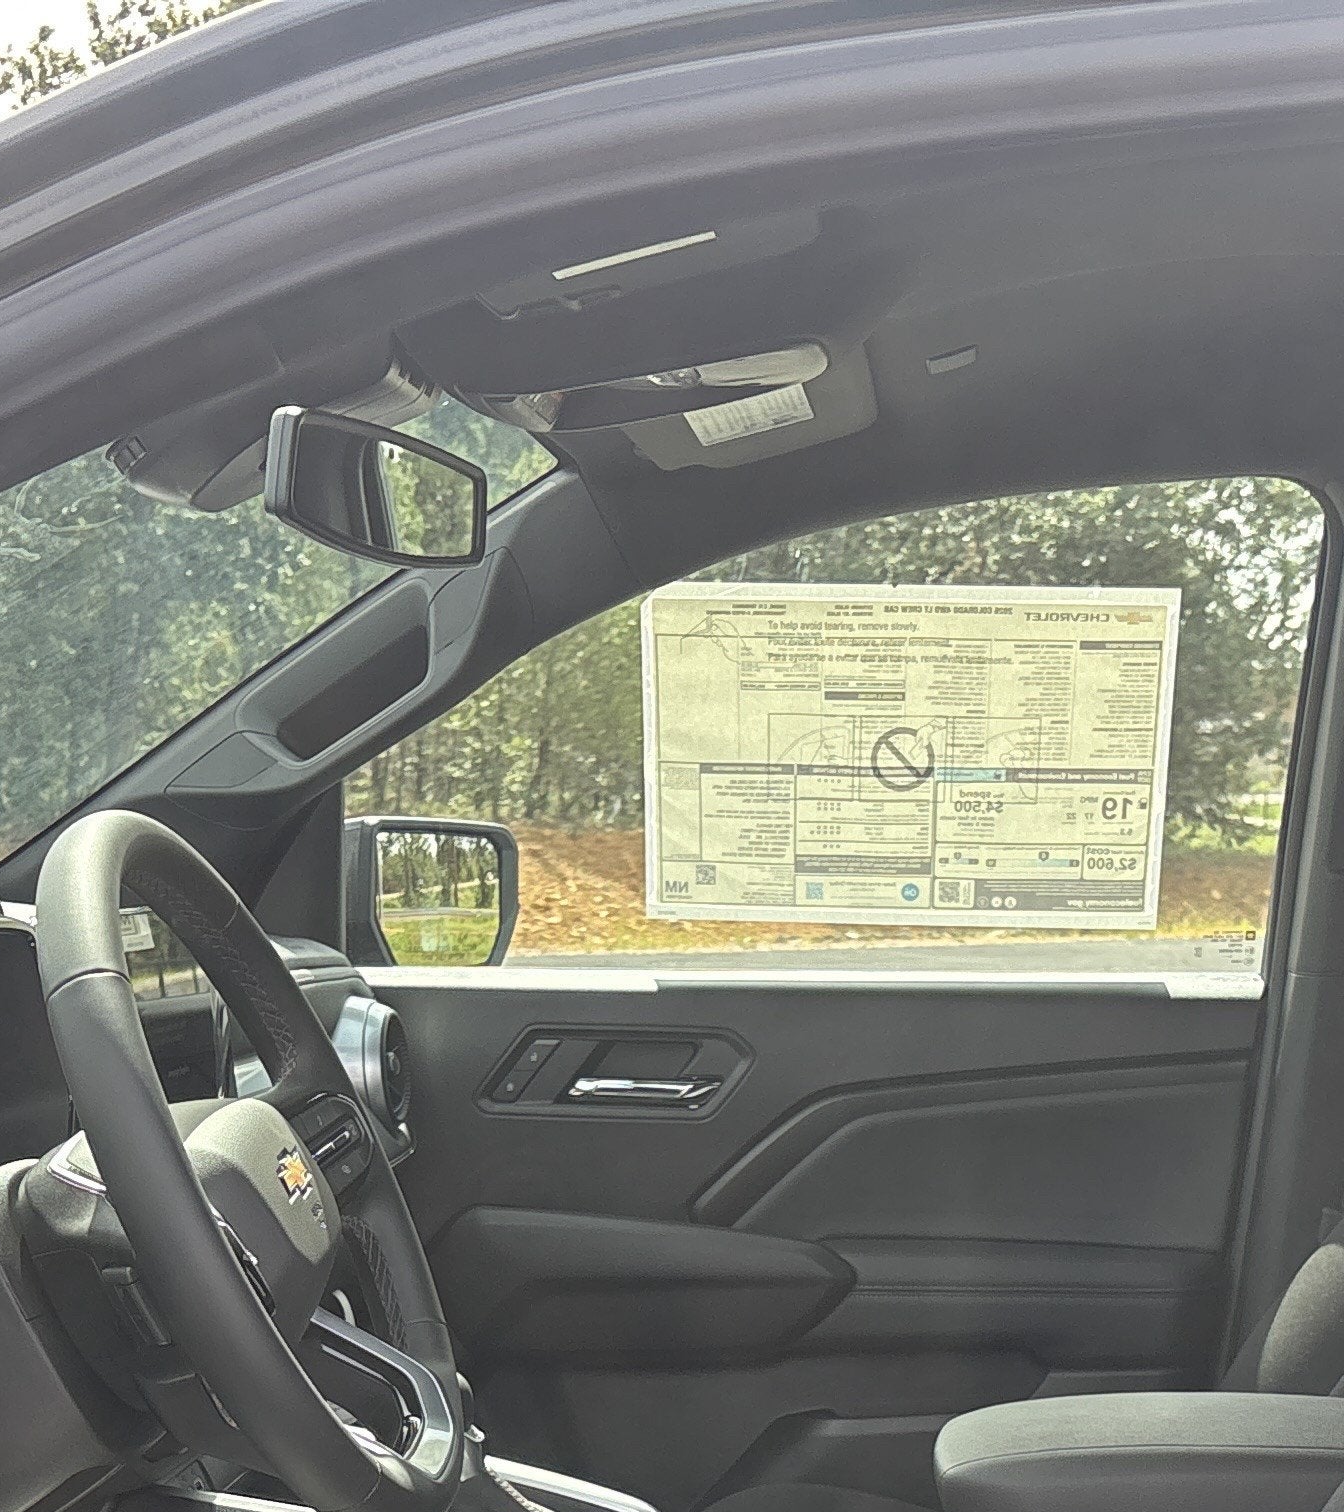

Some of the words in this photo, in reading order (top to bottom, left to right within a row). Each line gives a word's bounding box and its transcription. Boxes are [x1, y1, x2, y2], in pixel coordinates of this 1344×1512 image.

[768, 620, 779, 630] To
[780, 620, 798, 632] help
[799, 621, 823, 630] avoid
[857, 623, 889, 631] remove
